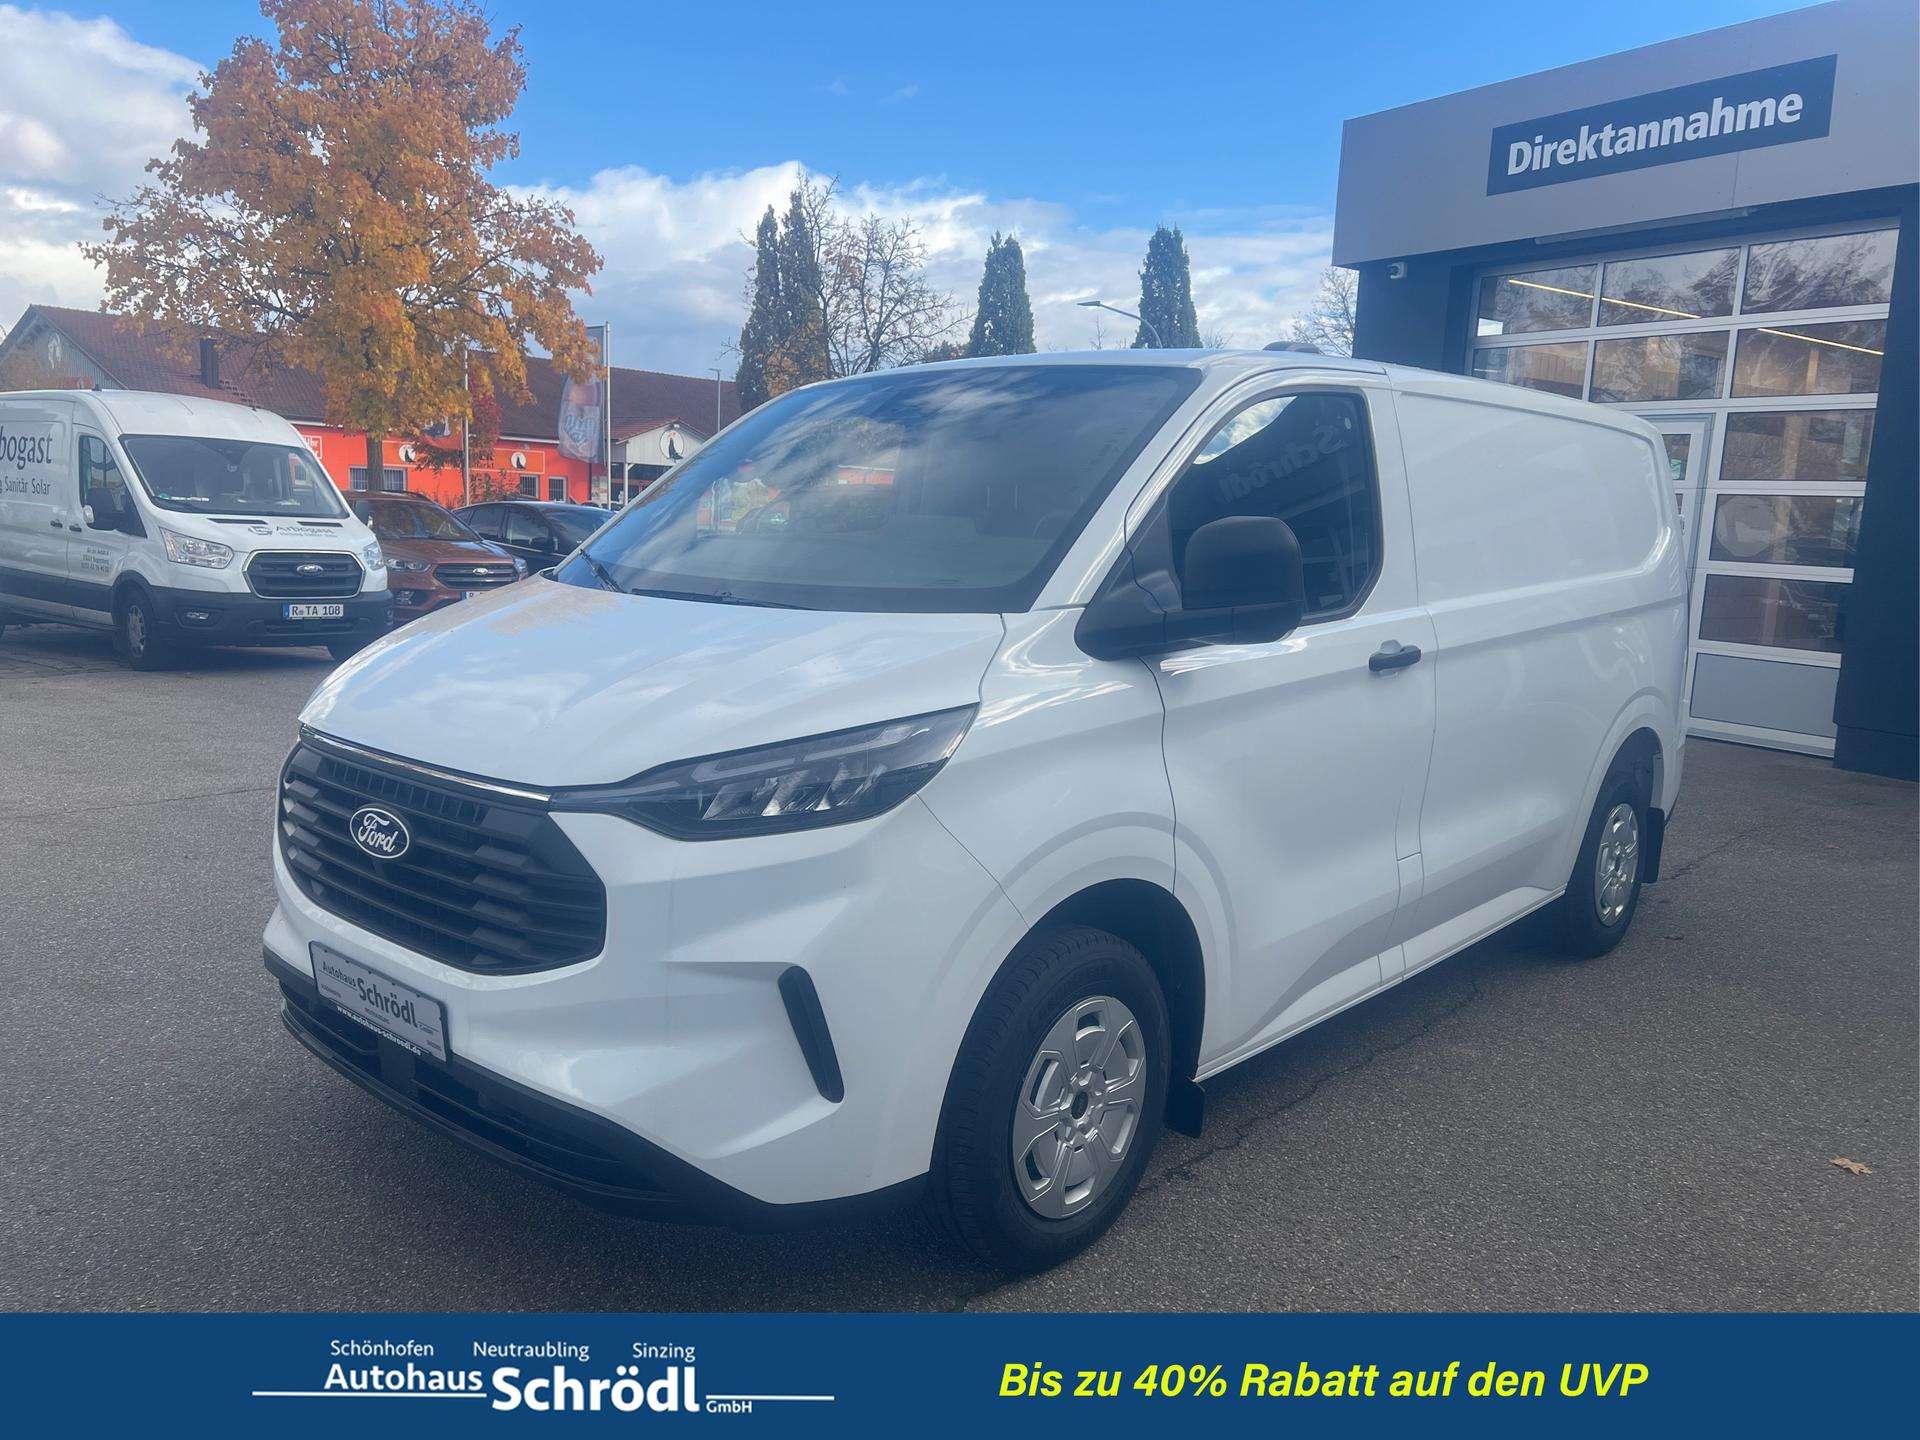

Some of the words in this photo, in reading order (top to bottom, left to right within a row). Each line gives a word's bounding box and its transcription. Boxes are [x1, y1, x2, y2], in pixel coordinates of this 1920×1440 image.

[1507, 93, 1804, 176] Direktannahme
[31, 478, 51, 495] Solar
[292, 605, 299, 616] R
[305, 605, 318, 616] TA
[322, 605, 341, 616] 108
[358, 813, 398, 853] Ford
[322, 960, 356, 988] Autohaus
[357, 977, 418, 1029] Schrödl
